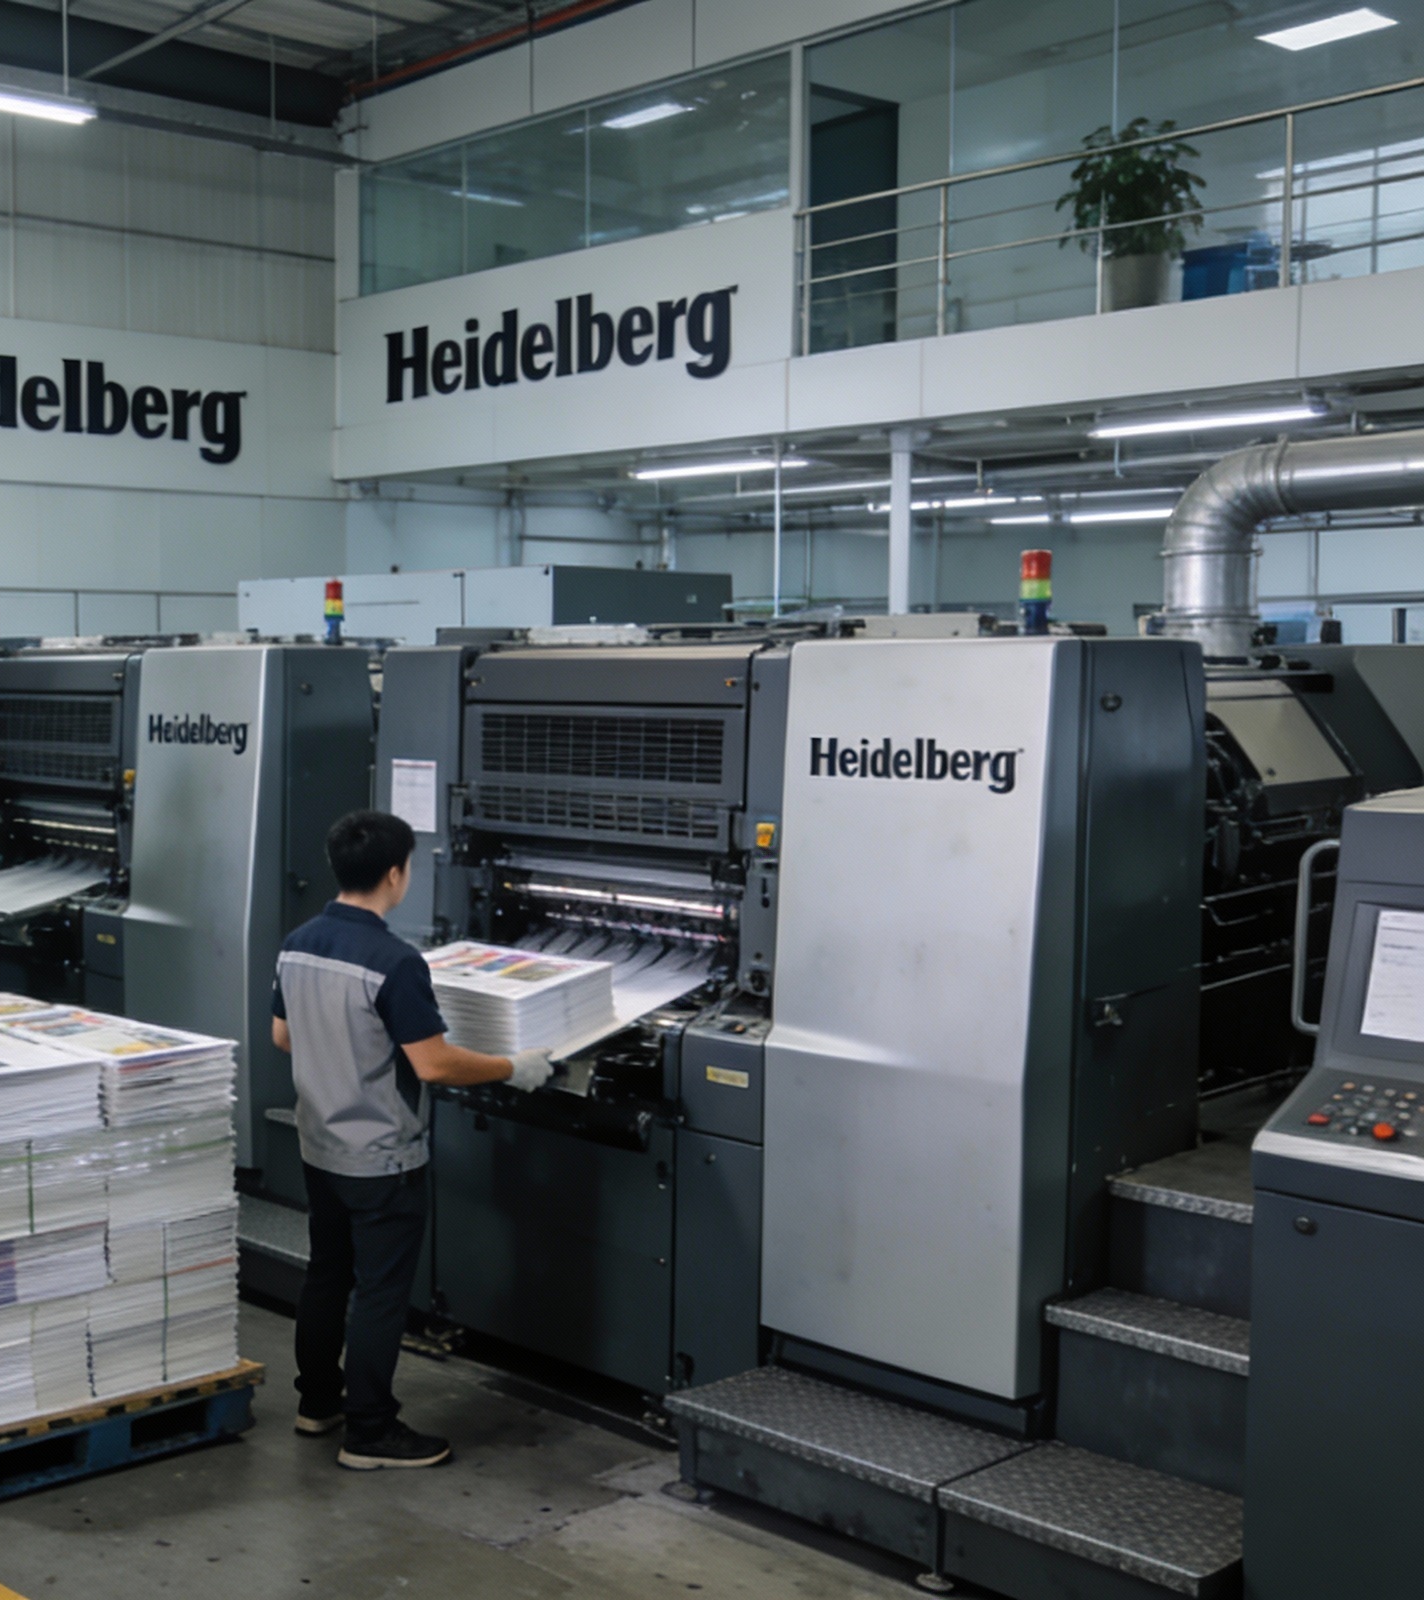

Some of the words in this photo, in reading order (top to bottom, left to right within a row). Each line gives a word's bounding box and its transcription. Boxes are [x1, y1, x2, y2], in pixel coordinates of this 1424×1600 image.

[384, 284, 739, 404] Heidelberg
[148, 713, 249, 755] Heidelberg
[809, 737, 1018, 795] Heidelberg
